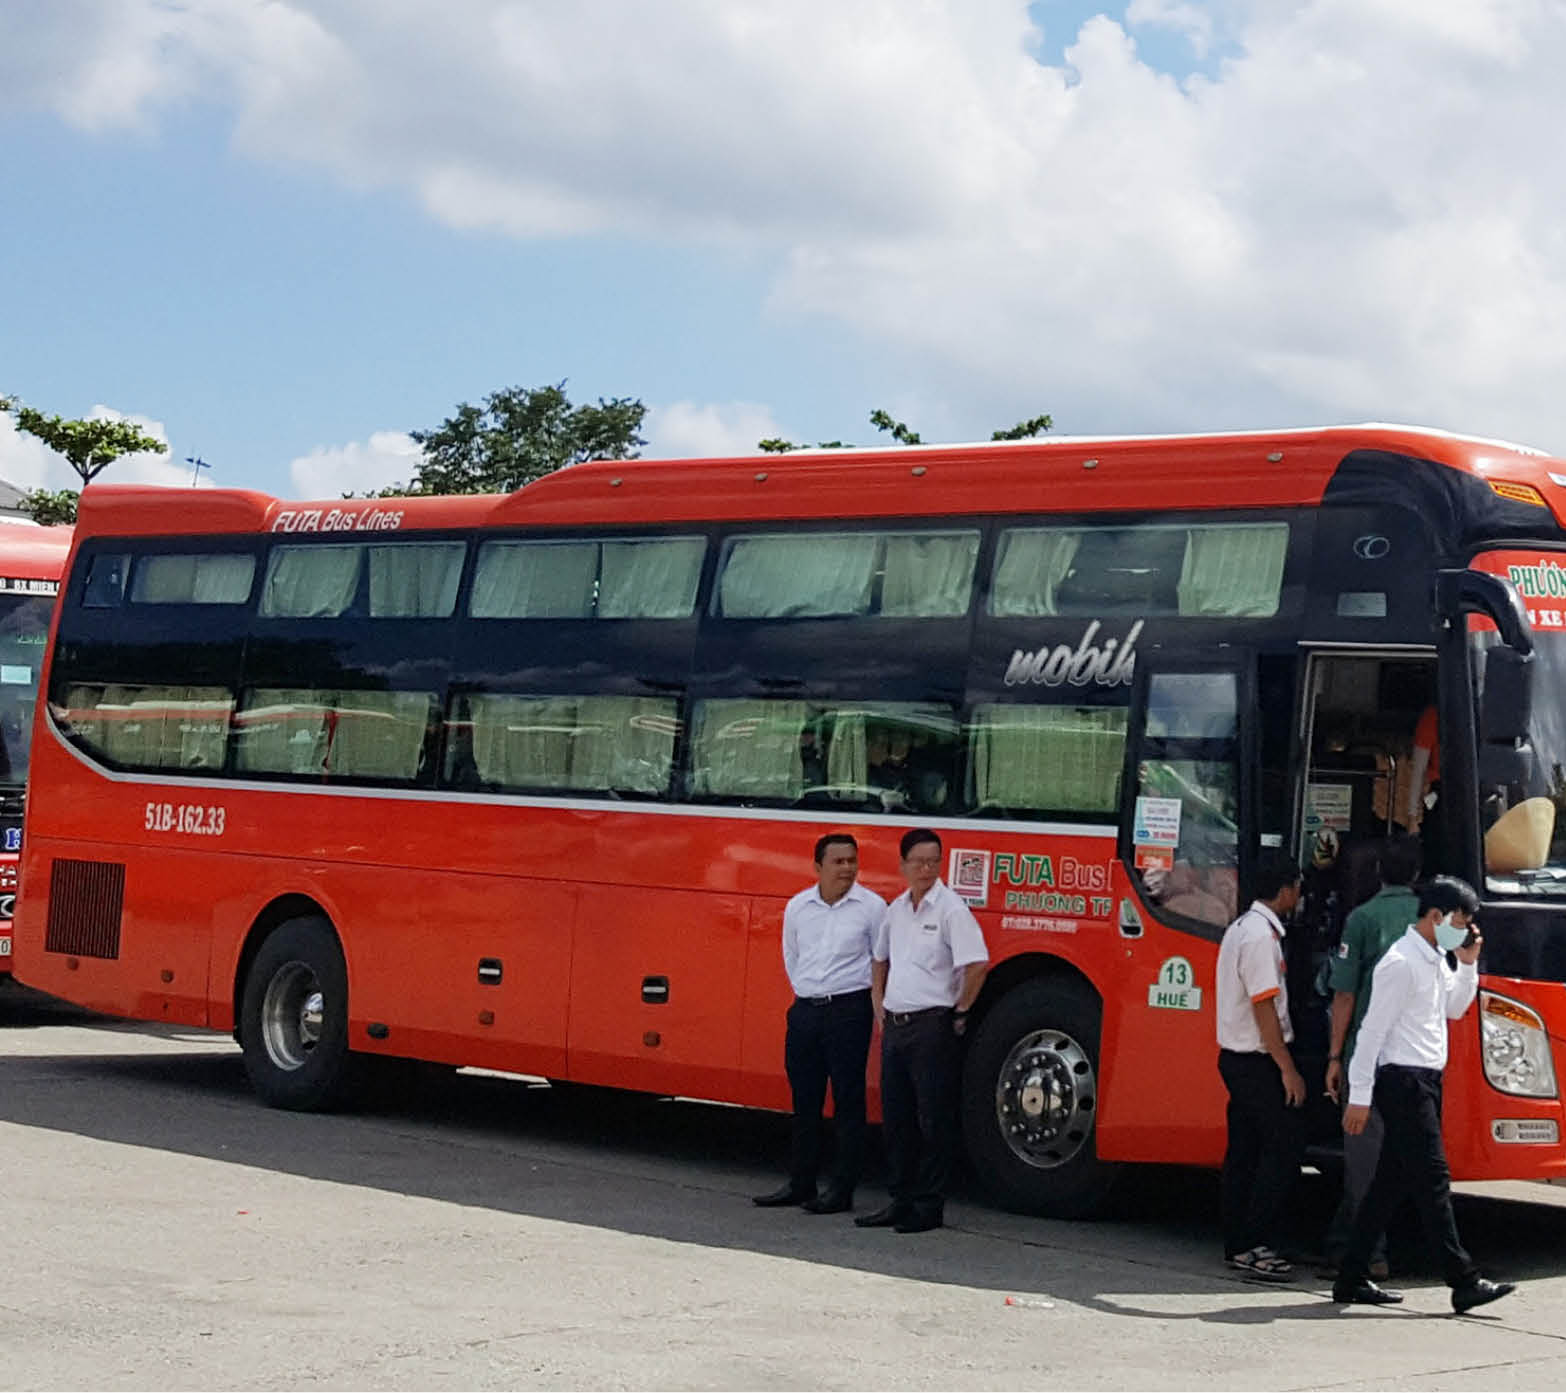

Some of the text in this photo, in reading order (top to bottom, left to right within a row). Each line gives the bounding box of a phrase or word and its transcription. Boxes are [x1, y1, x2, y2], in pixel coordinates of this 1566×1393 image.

[271, 506, 404, 532] FUTA Bus Lines
[1539, 609, 1563, 627] XE
[144, 802, 226, 836] 51B-162.33
[993, 852, 1055, 887] FUTA
[1058, 856, 1106, 892] Bus
[1166, 962, 1188, 985] 13
